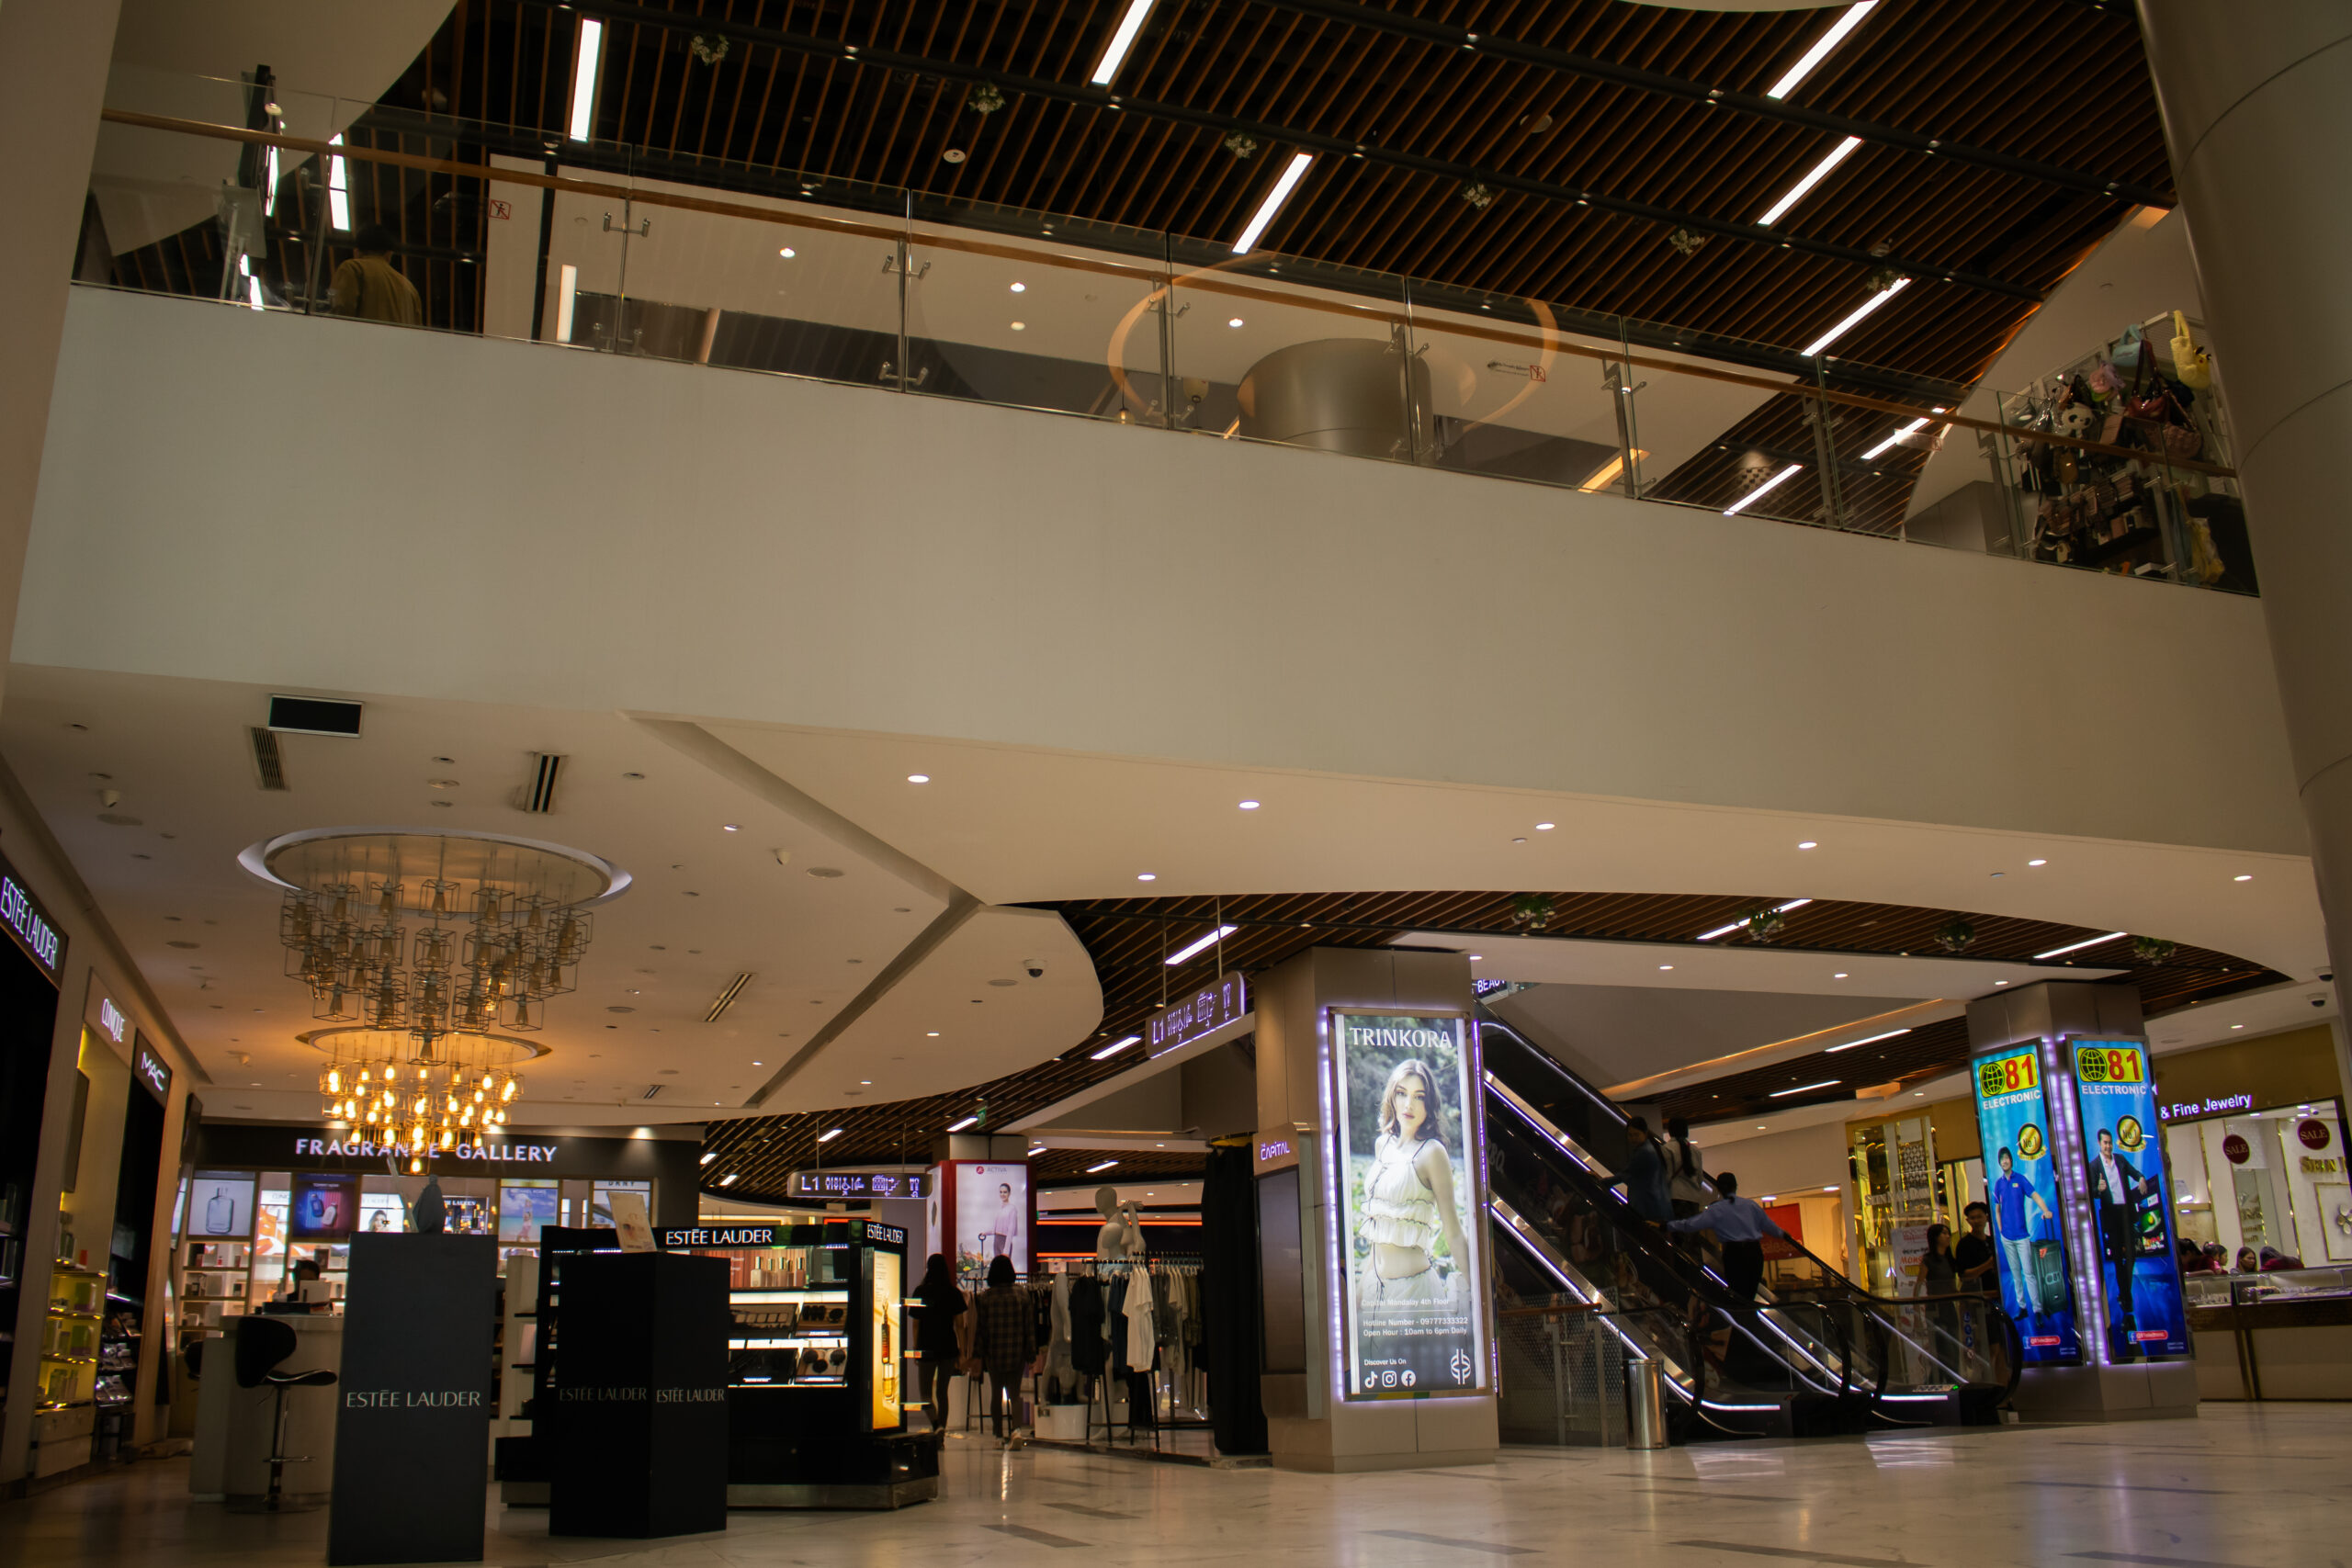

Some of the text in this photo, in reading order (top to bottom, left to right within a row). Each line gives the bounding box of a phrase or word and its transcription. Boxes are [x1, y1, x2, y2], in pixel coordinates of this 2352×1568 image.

[25, 908, 58, 970] LAUDER
[1477, 979, 1505, 993] BEAU
[101, 998, 126, 1043] CLINIQUE
[1154, 1018, 1164, 1044] L1
[1349, 1027, 1453, 1048] TRINKORA
[2005, 1055, 2034, 1089] 81
[2108, 1050, 2140, 1080] 81
[2082, 1084, 2147, 1096] ELECTRONIC
[1983, 1089, 2041, 1111] ELECTRONIC
[2160, 1093, 2252, 1120] & Fine Jewelry
[2300, 1128, 2329, 1141] SALE
[295, 1138, 558, 1162] FRAGRANE GALLERY
[2224, 1143, 2248, 1156] SALE
[800, 1175, 820, 1191] L1
[712, 1229, 772, 1244] LAUDER
[883, 1226, 903, 1244] LAUDER
[1387, 1298, 1419, 1307] Mandalay
[1388, 1318, 1415, 1326] Number
[1363, 1329, 1380, 1337] Open
[1434, 1327, 1450, 1336] 6pm
[1451, 1326, 1467, 1336] Daily
[406, 1390, 481, 1407] LAUDER
[597, 1386, 648, 1402] LAUDER
[686, 1387, 726, 1403] LAUDER
